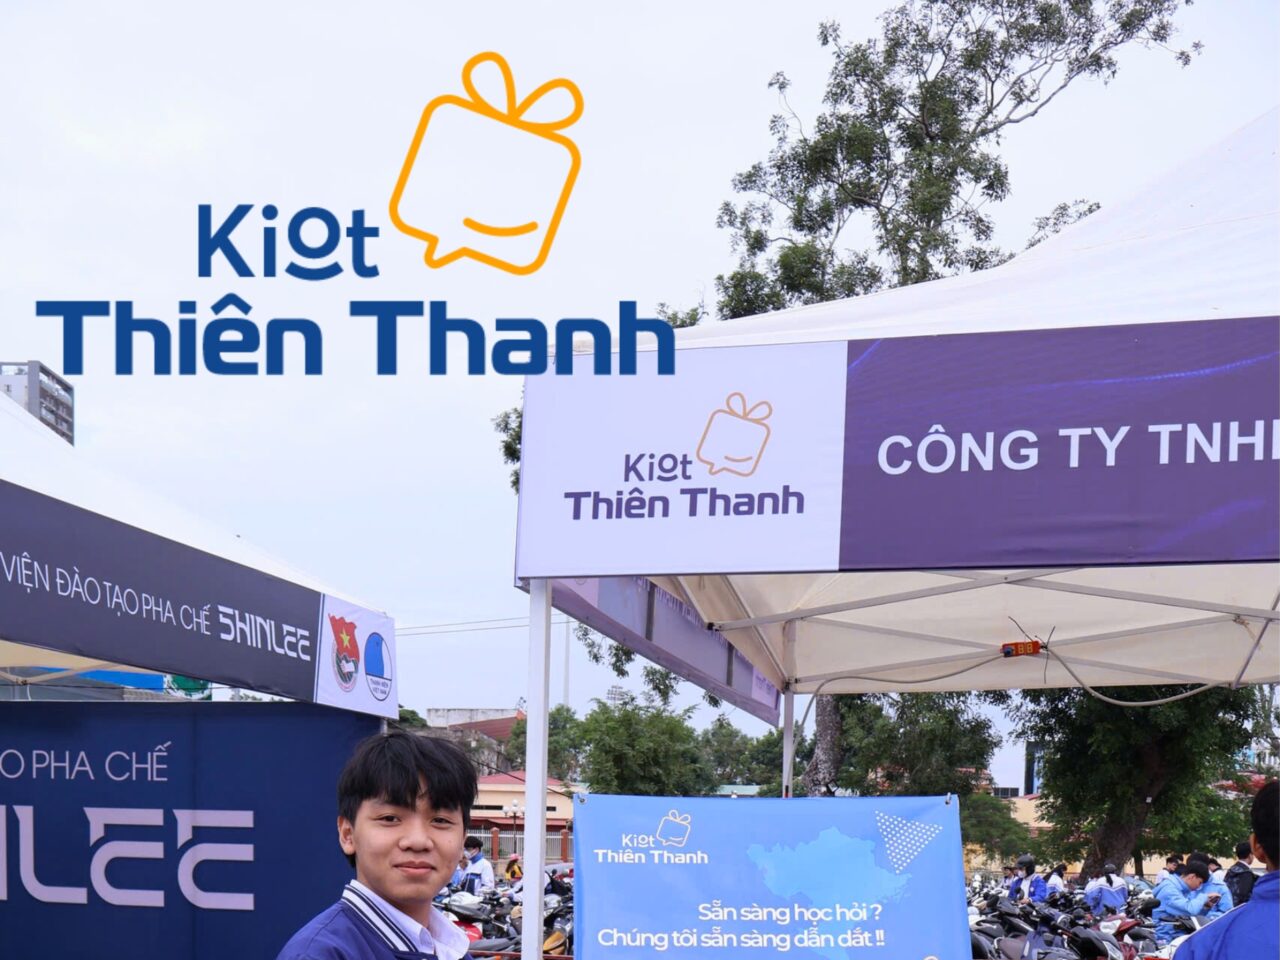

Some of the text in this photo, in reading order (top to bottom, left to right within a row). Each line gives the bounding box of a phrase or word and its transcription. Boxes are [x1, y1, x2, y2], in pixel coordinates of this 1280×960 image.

[876, 424, 1040, 477] CÔNG
[1059, 425, 1132, 469] TY
[623, 452, 694, 483] Kiot
[564, 484, 805, 521] Thiên Thanh
[0, 551, 311, 661] VIỆN ĐÀO TẠO PHA CHẾ SHINLEE
[32, 750, 95, 780] PHA
[105, 741, 169, 782] CHẾ
[621, 833, 656, 848] Kiot
[593, 849, 709, 864] Thiên Thanh
[697, 899, 882, 926] Sẵn sàng học hỏi ?
[597, 928, 668, 951] Chúng
[671, 929, 697, 947] tôi
[700, 926, 737, 948] sẵn
[740, 930, 790, 951] sàng
[794, 923, 834, 948] dẫn
[837, 926, 873, 947] dắt
